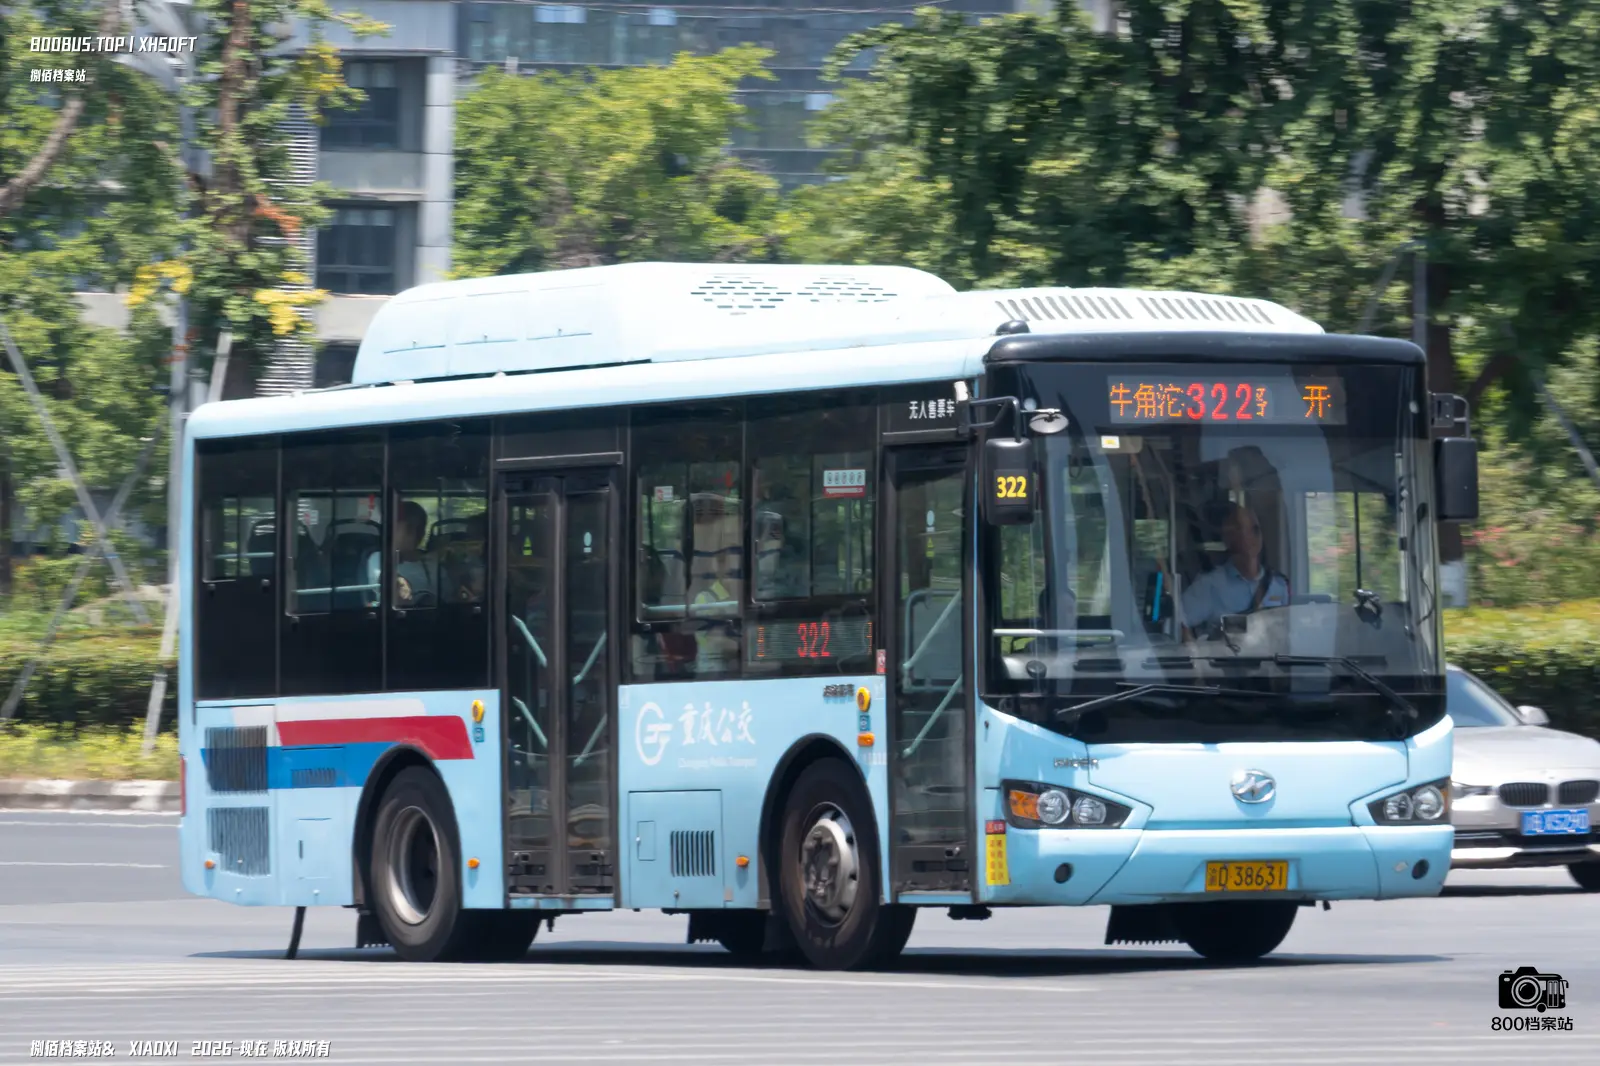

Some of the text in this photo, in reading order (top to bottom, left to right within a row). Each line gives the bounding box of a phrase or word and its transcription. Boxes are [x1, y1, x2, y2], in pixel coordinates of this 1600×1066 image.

[909, 398, 955, 419] 无人售票车
[1186, 383, 1253, 420] 322
[996, 475, 1027, 498] 322
[797, 621, 831, 658] 322
